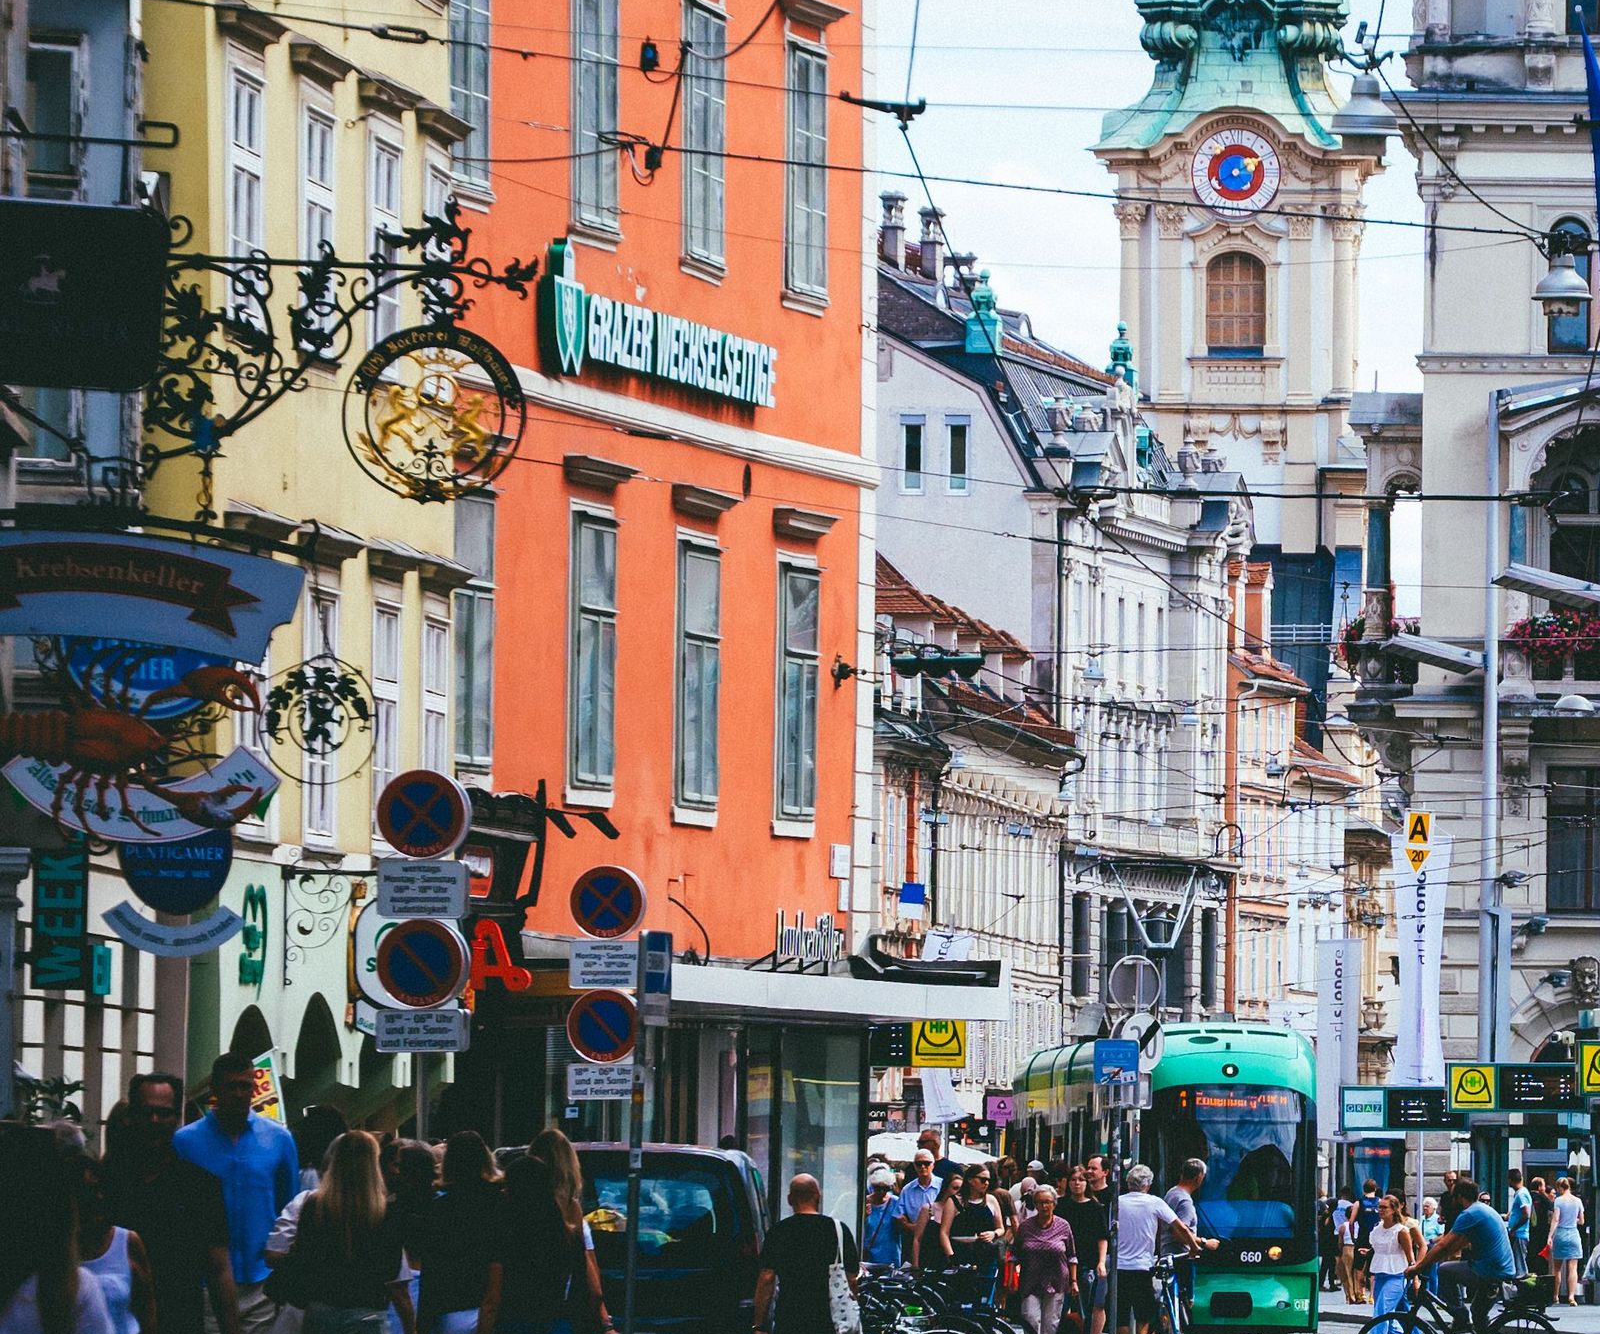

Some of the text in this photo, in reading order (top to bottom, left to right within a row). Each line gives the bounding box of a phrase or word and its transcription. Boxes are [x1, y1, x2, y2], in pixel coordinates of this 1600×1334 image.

[588, 293, 778, 409] GRAZER WECHSELSEITIGE
[15, 556, 205, 595] Krebsenkeller
[1409, 815, 1428, 842] A
[401, 841, 443, 855] ANFANG
[1412, 850, 1424, 862] 20
[402, 866, 441, 875] werktags
[595, 928, 618, 937] ENDE
[397, 992, 439, 1007] ANFANG
[435, 1014, 454, 1023] Uhr
[385, 1025, 453, 1035] und an Sonn-
[381, 1038, 457, 1051] und Feiertagen
[591, 1052, 613, 1061] ENDE
[575, 1077, 591, 1085] und
[571, 1088, 587, 1096] und
[1346, 1103, 1382, 1113] GRAZ
[1240, 1251, 1262, 1263] 660
